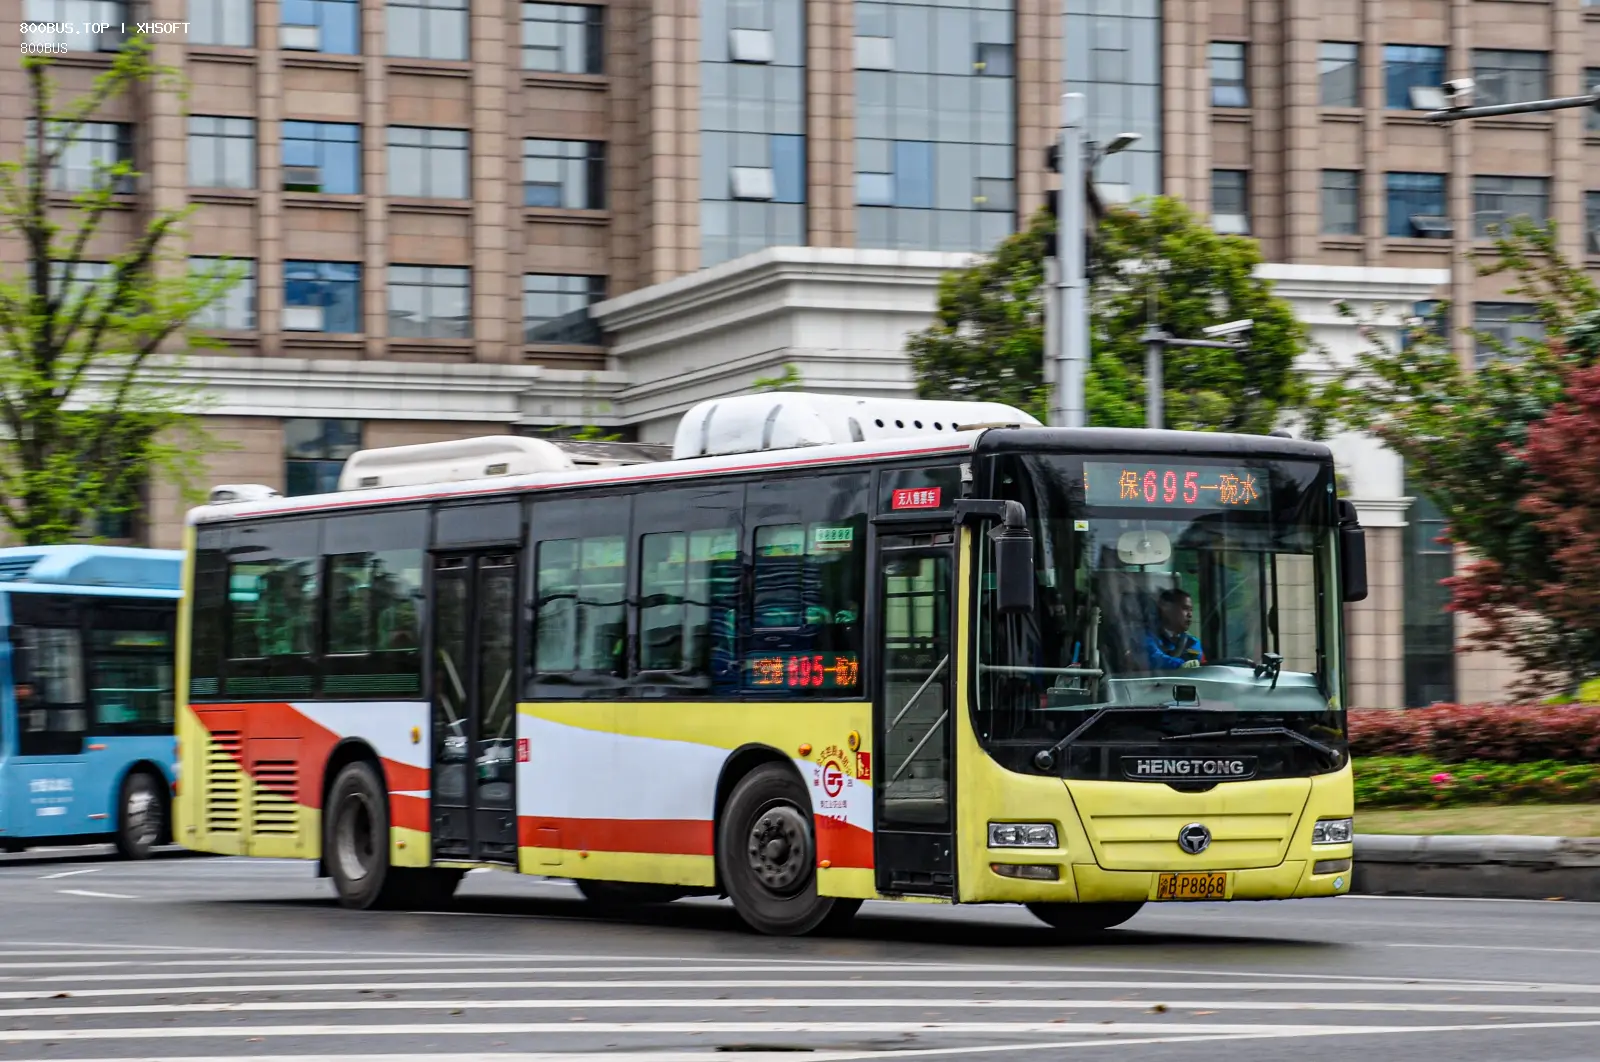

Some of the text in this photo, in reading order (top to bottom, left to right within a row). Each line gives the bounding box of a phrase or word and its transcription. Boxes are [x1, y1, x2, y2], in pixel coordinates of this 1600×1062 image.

[1143, 470, 1199, 503] 695
[898, 490, 936, 505] 无人售票车
[1137, 760, 1244, 774] HENGTONG
